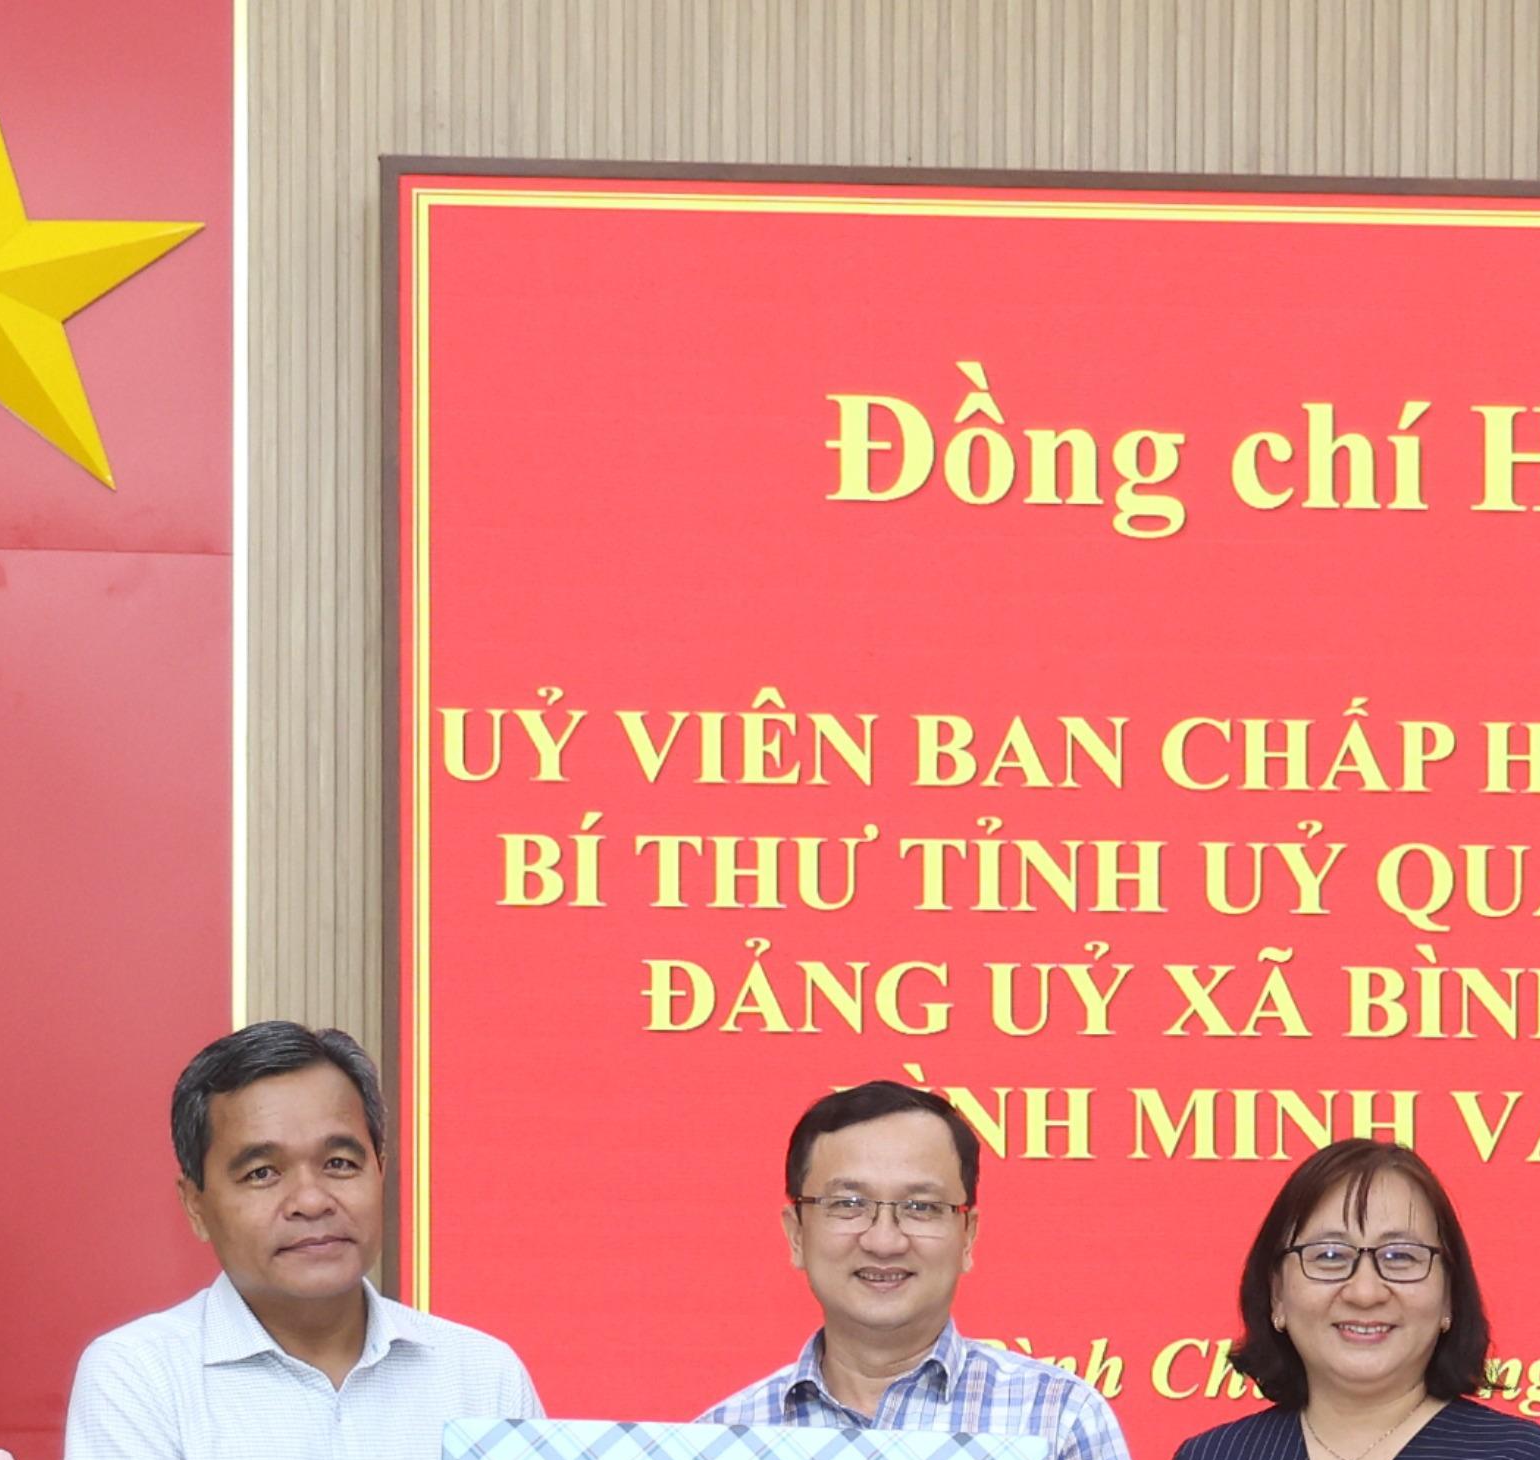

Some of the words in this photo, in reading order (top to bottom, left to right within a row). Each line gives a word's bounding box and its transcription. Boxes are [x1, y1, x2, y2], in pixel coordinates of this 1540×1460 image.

[824, 360, 1187, 540] Đồng
[1230, 399, 1432, 511] chí
[438, 686, 587, 783] UỶ
[614, 686, 879, 786] VIÊN
[912, 713, 1129, 789] BAN
[1160, 696, 1457, 793] CHẤP
[496, 812, 607, 908] BÍ
[634, 823, 880, 911] THƯ
[898, 815, 1169, 914] TỈNH
[1201, 819, 1348, 916] UỶ
[640, 937, 953, 1036] ĐẢNG
[985, 941, 1135, 1037] UỶ
[1162, 946, 1313, 1039] XÃ
[1127, 1087, 1419, 1161] MINH
